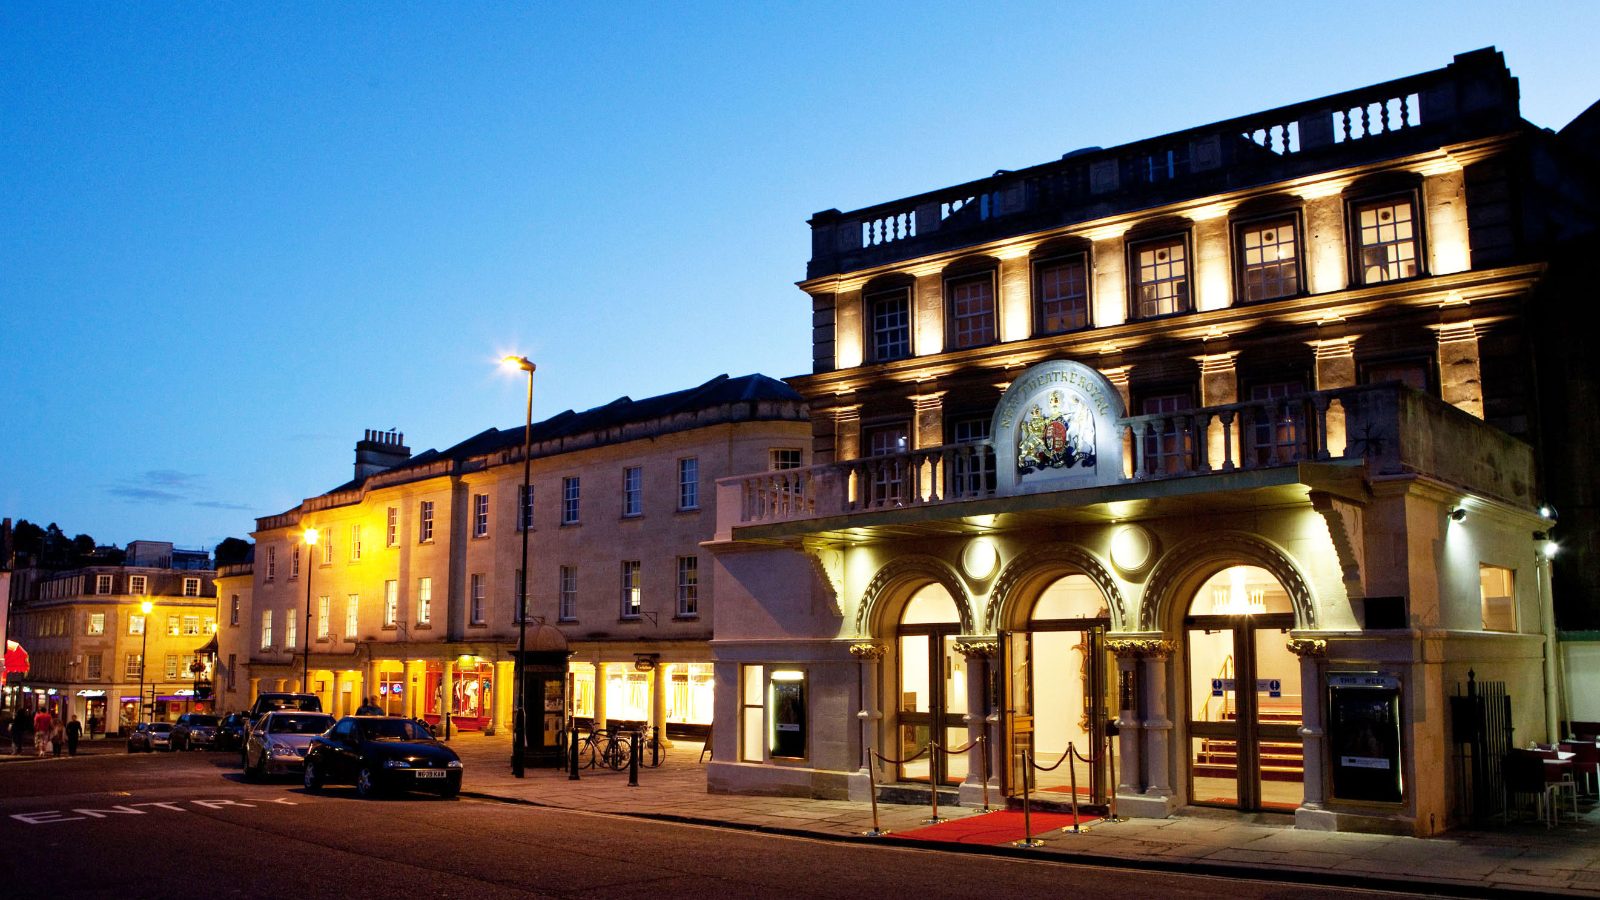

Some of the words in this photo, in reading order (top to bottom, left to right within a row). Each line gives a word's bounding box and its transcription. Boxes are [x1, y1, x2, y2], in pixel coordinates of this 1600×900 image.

[1019, 370, 1077, 398] THEATRE
[1078, 375, 1109, 415] ROYAL
[10, 797, 300, 824] ENTRY
